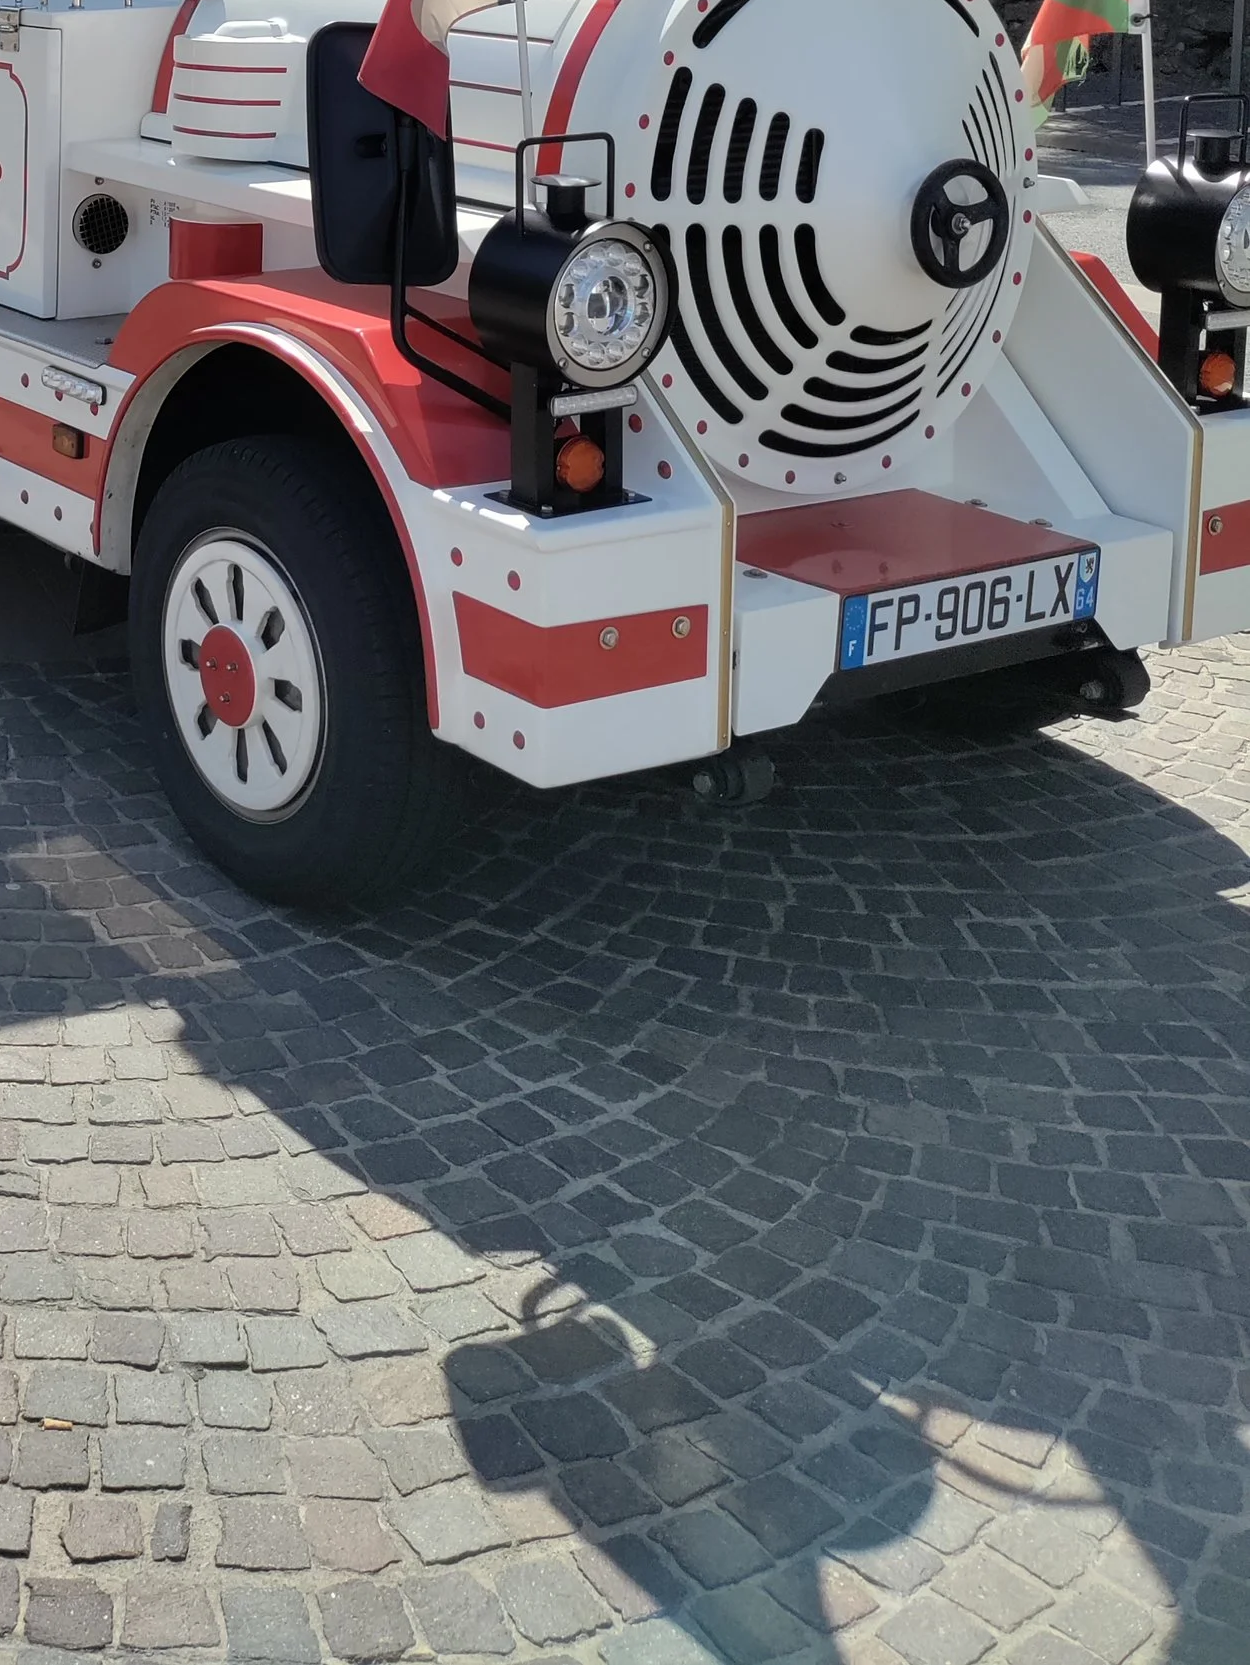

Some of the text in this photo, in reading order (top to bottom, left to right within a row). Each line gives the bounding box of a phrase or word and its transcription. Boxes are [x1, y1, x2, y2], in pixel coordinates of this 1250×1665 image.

[866, 561, 1075, 657] FP-906-LX
[1075, 588, 1095, 611] 64
[848, 640, 857, 657] F
